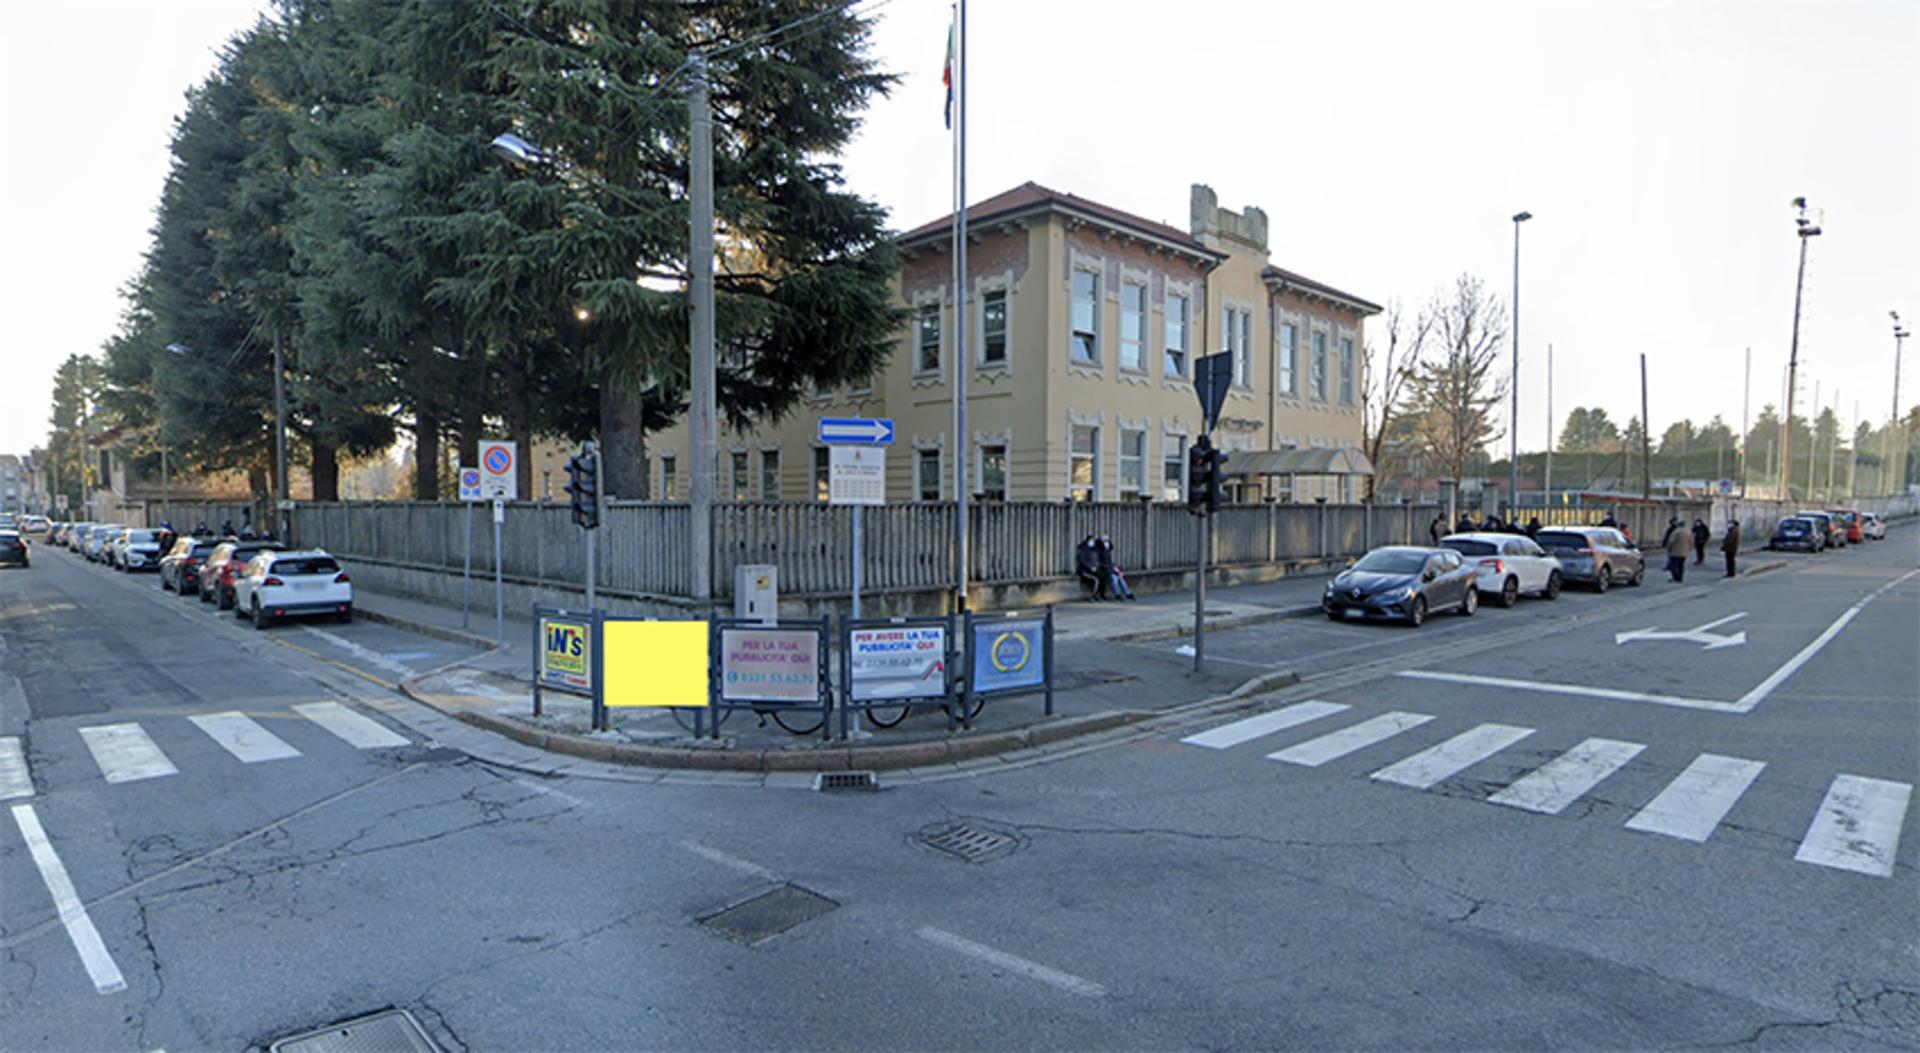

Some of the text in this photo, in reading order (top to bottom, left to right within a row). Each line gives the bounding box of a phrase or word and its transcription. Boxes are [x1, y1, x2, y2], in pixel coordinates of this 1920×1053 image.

[856, 630, 940, 641] PER AVERE LA TUA
[743, 641, 799, 651] PER LA TUA
[916, 641, 936, 651] QUI
[790, 652, 811, 663] QUI
